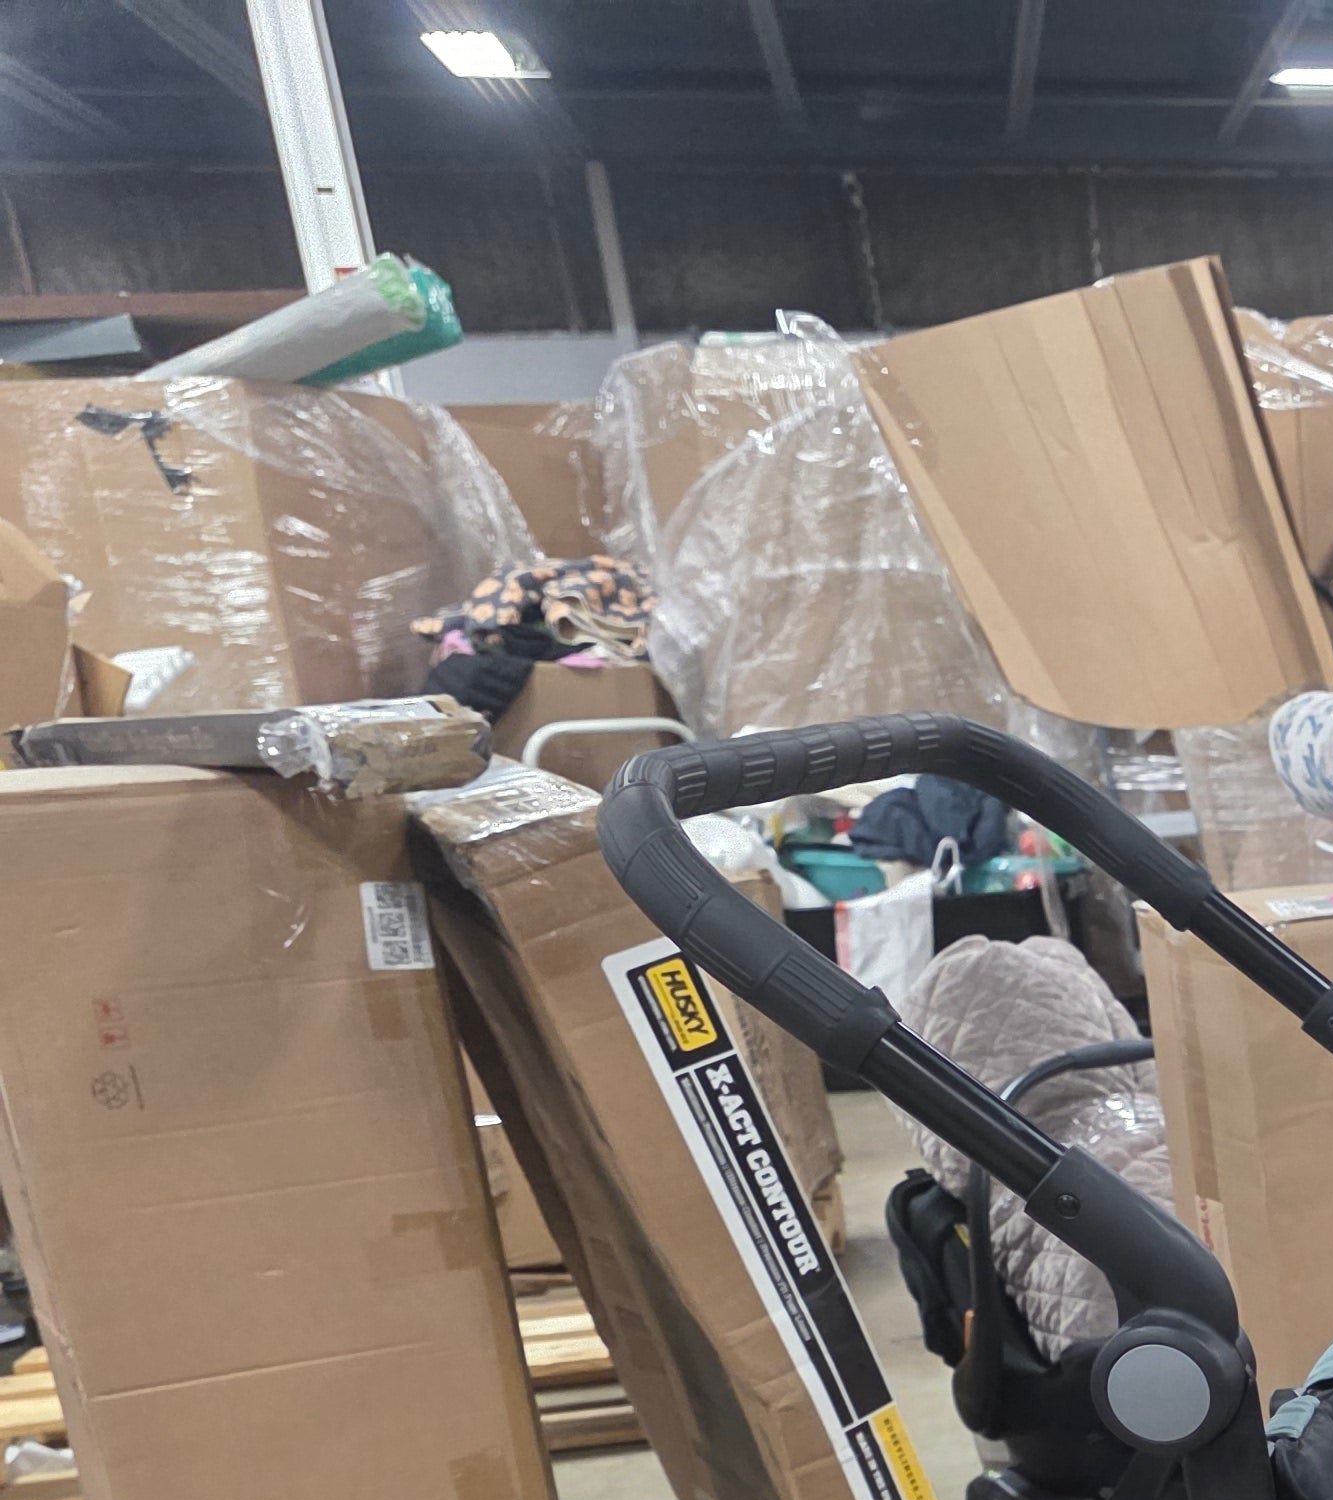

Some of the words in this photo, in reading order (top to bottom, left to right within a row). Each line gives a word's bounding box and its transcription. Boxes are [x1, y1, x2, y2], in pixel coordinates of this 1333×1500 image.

[661, 969, 709, 1036] HUSKY
[705, 1063, 762, 1147] X-ACT
[746, 1148, 819, 1276] CONTOUR
